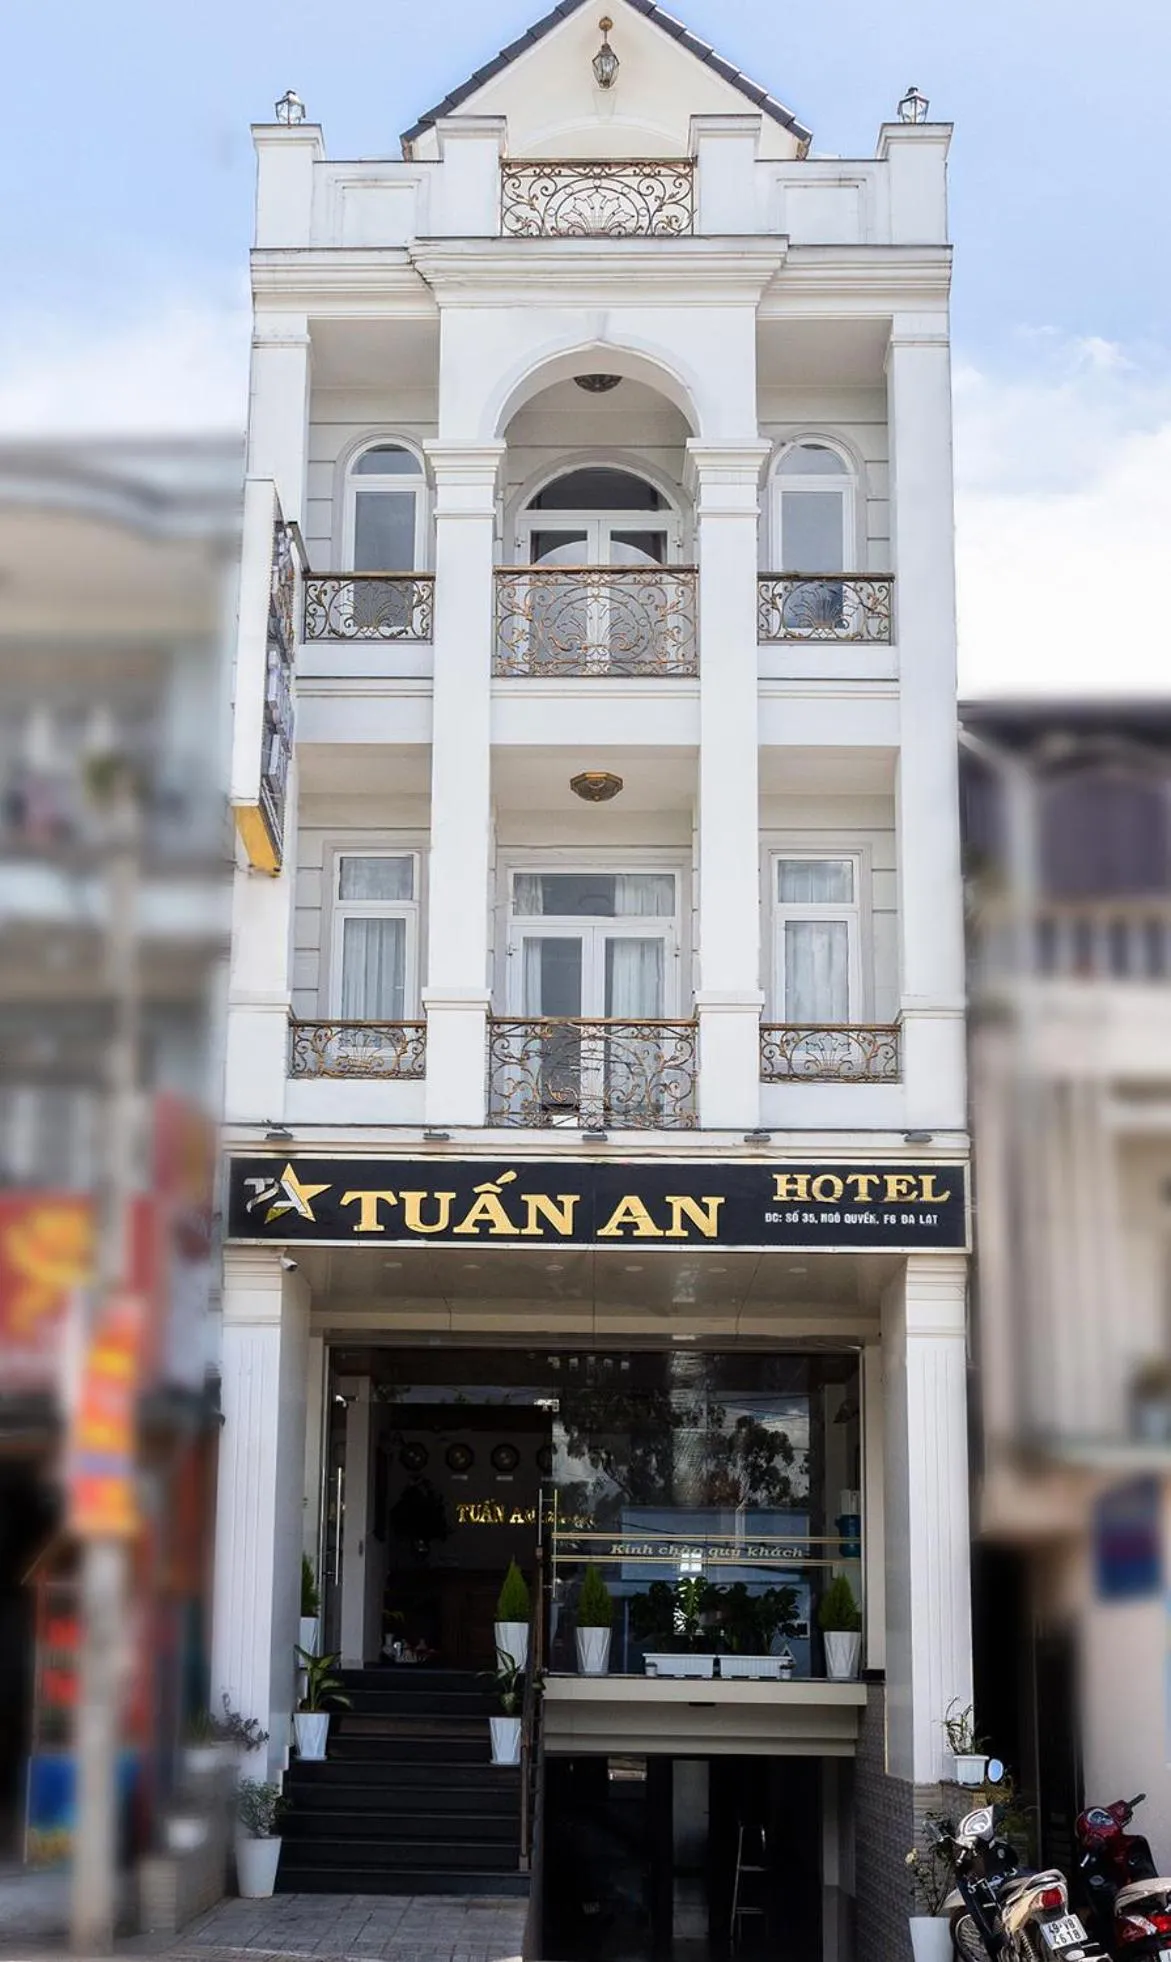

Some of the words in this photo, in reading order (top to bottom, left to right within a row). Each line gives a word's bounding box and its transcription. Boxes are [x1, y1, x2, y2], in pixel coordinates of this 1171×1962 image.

[340, 1169, 580, 1236] TUẤN
[597, 1195, 725, 1237] AN
[771, 1173, 951, 1203] HOTEL
